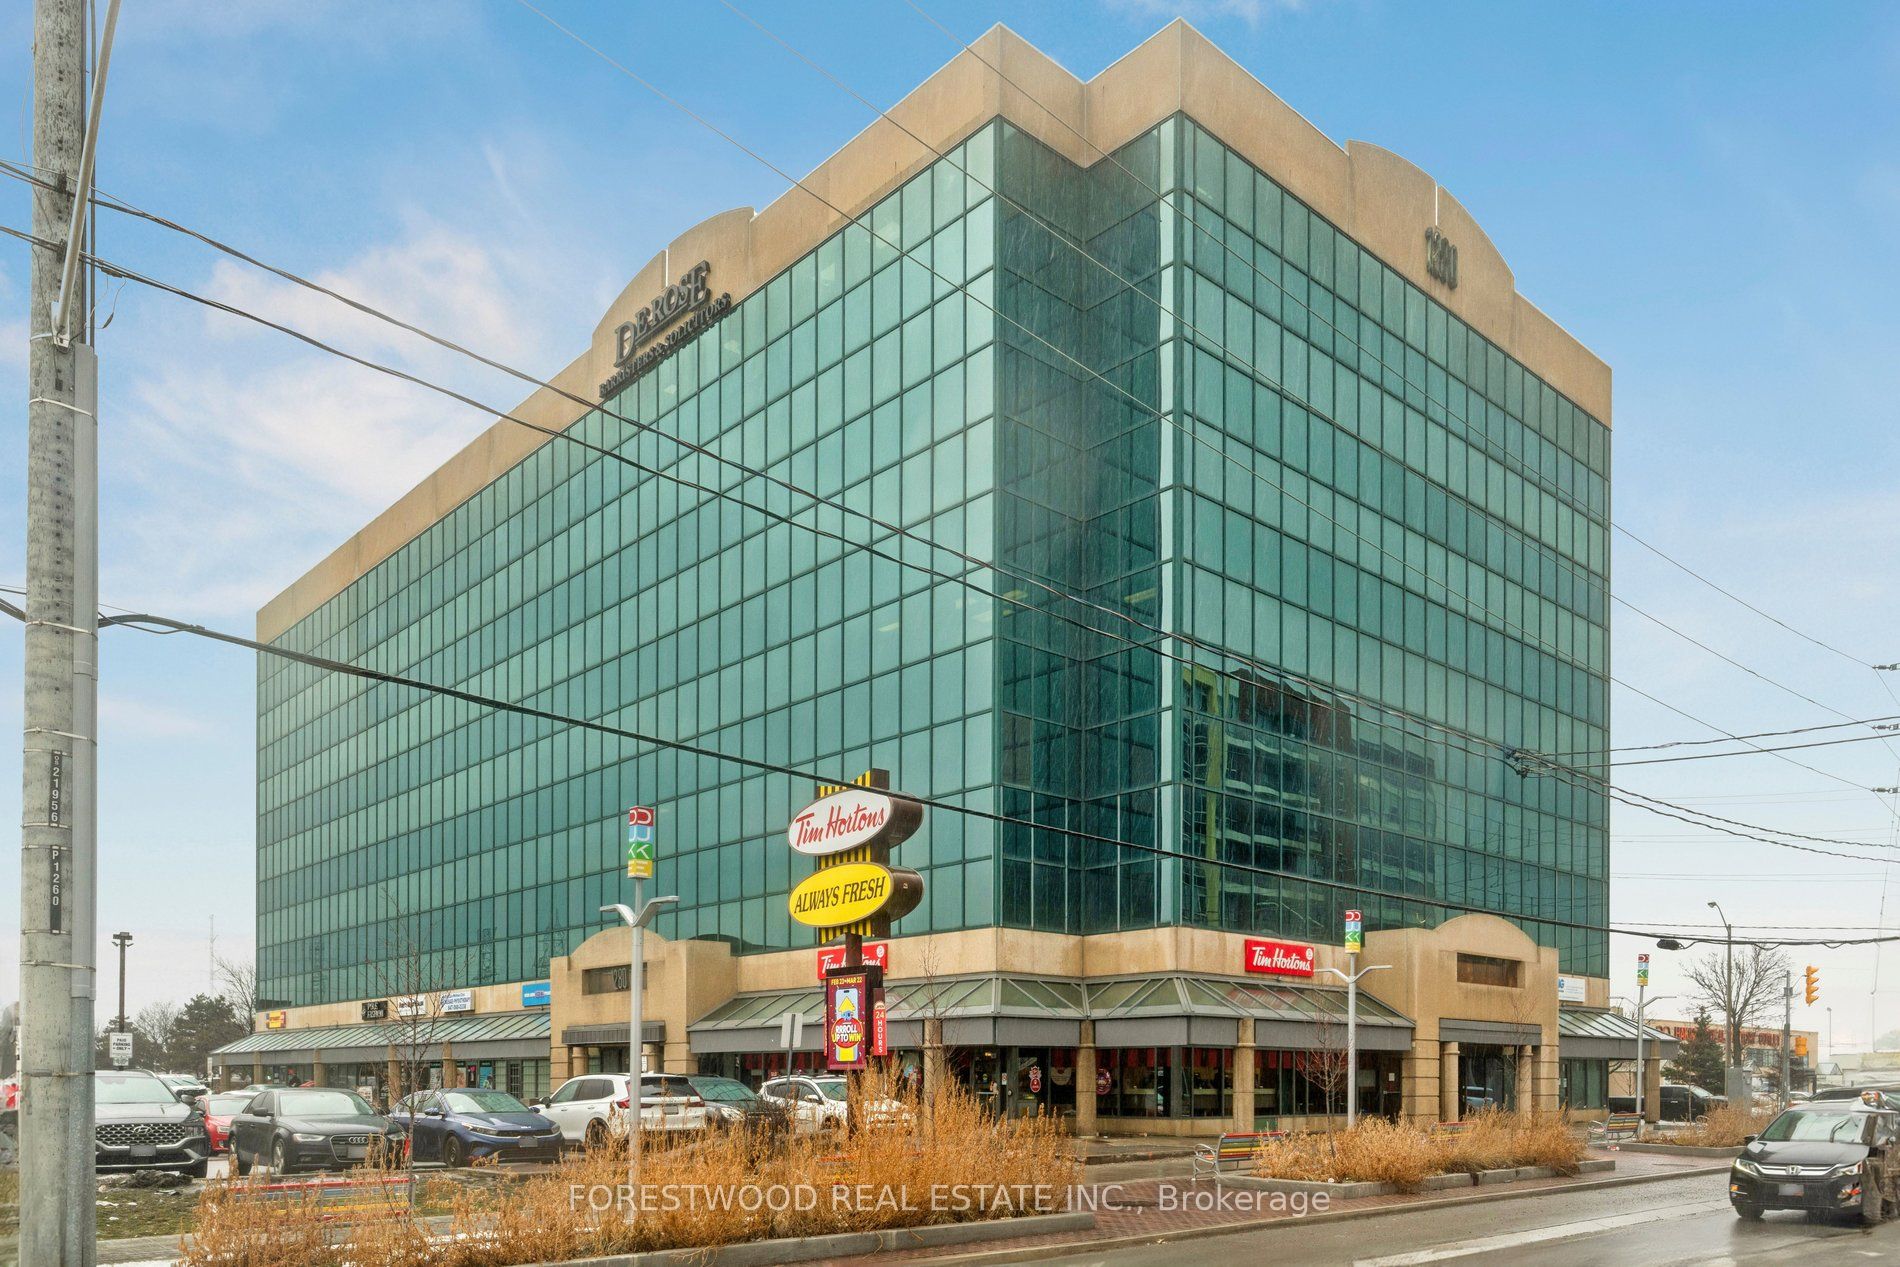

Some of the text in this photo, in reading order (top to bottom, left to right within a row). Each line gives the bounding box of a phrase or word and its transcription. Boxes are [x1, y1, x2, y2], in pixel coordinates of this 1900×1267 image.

[665, 292, 731, 349] SOLICITORS
[51, 766, 60, 822] 21956
[795, 803, 885, 847] Tim Hortons
[794, 876, 886, 914] ALWAYS FRESH
[1252, 947, 1311, 971] Tim Hortons
[875, 1011, 885, 1019] 24
